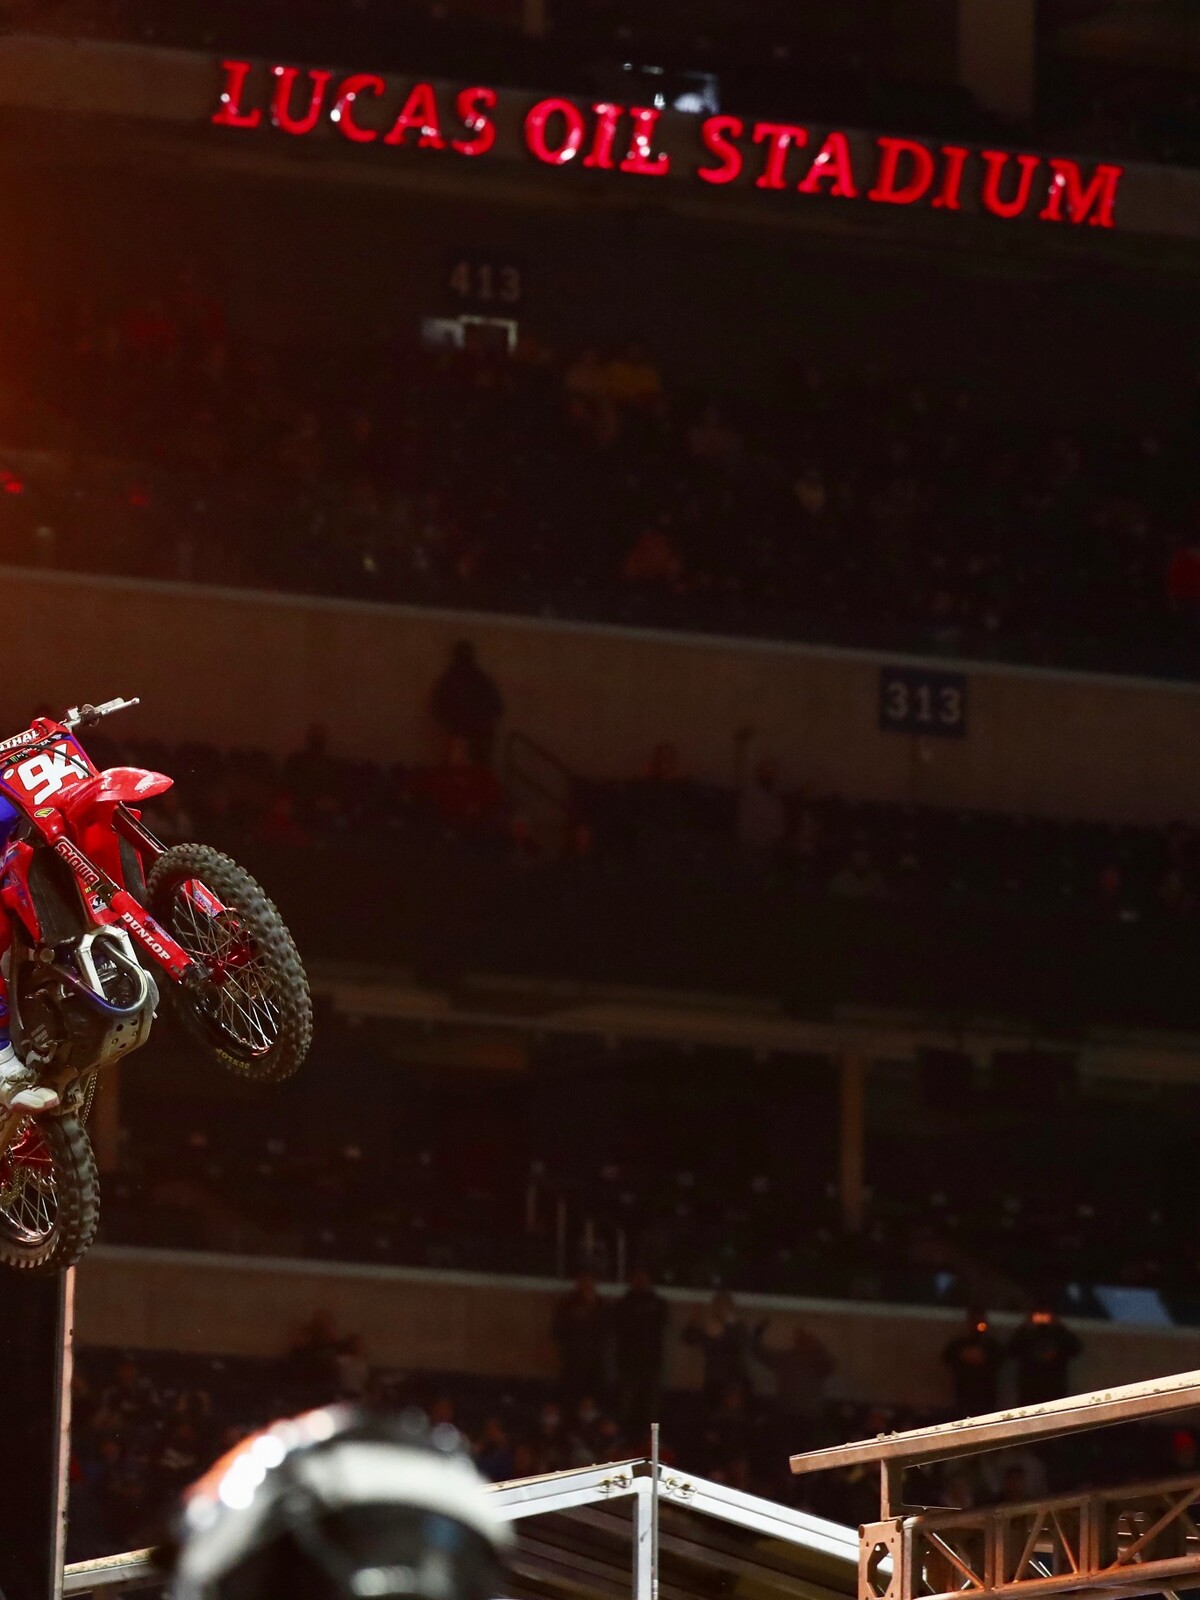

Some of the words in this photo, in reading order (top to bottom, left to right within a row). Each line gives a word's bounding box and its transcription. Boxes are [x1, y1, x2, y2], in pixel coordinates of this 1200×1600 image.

[212, 60, 498, 156] LUCAS
[525, 97, 669, 176] OIL
[697, 115, 1124, 229] STADIUM
[449, 261, 521, 303] 413
[885, 681, 961, 725] 313
[17, 743, 89, 805] 94
[55, 841, 99, 885] SHOWA
[121, 912, 171, 960] DUNLOP
